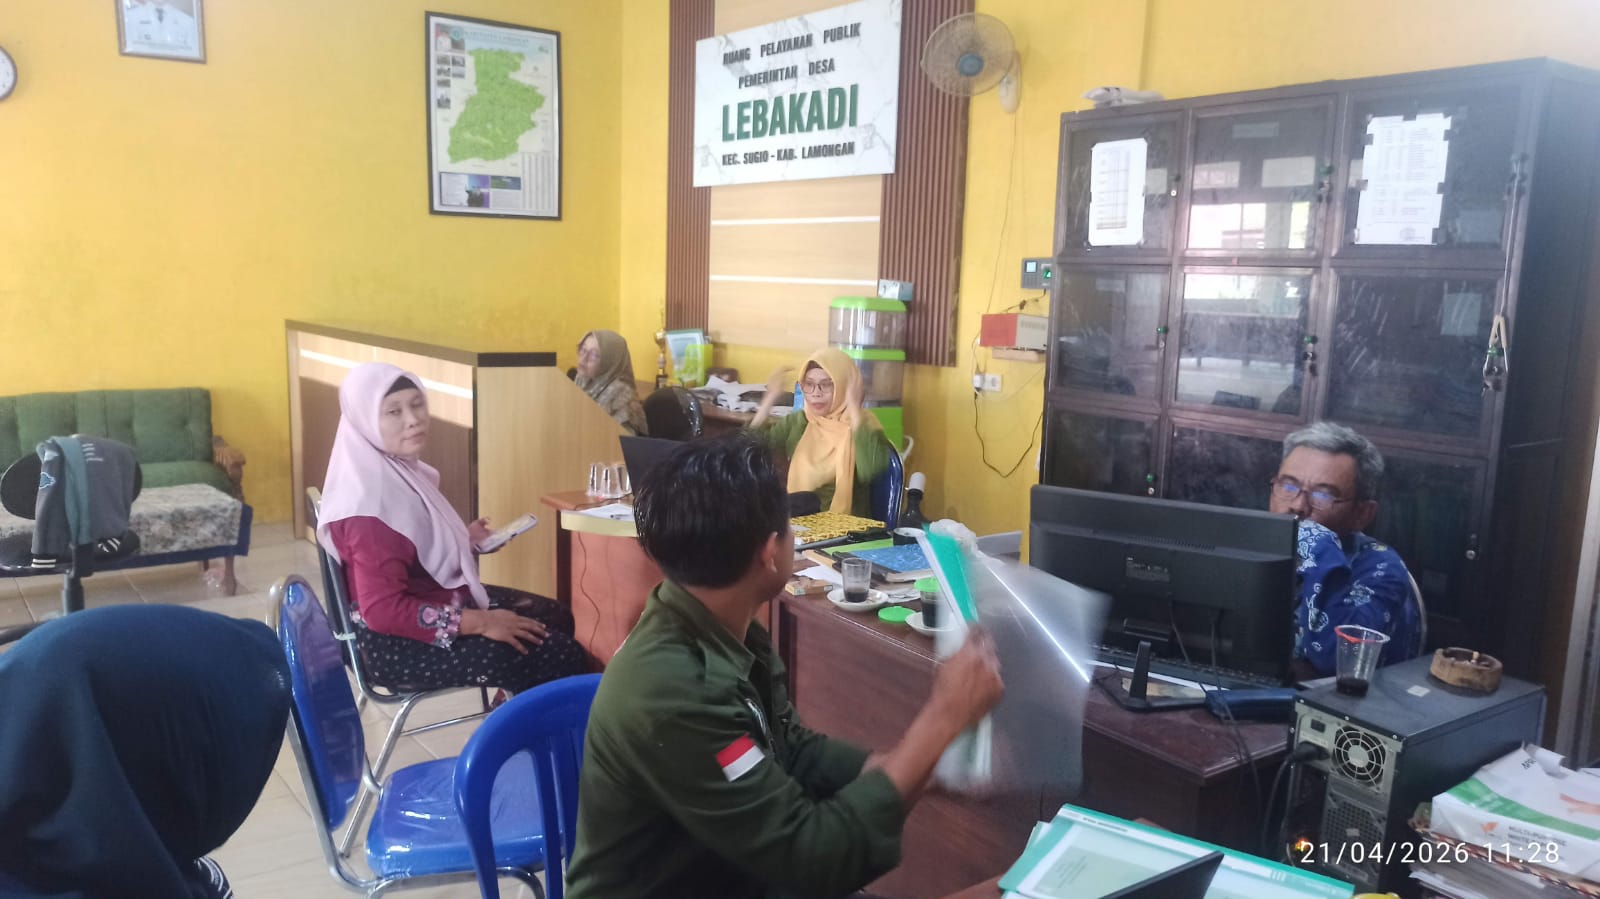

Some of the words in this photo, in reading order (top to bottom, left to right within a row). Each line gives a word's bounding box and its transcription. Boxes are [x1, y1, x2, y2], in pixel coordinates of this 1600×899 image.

[723, 48, 750, 66] RUANG
[760, 33, 813, 58] PELAYANAN
[823, 22, 861, 44] PUBLIK
[738, 65, 798, 89] PEMERINTAH
[808, 58, 835, 76] DESA
[722, 84, 858, 142] LEBAKADI
[722, 153, 741, 166] KEC.
[743, 151, 768, 164] SUGIO
[777, 148, 797, 161] KAB.
[802, 142, 855, 159] LAMONGAN
